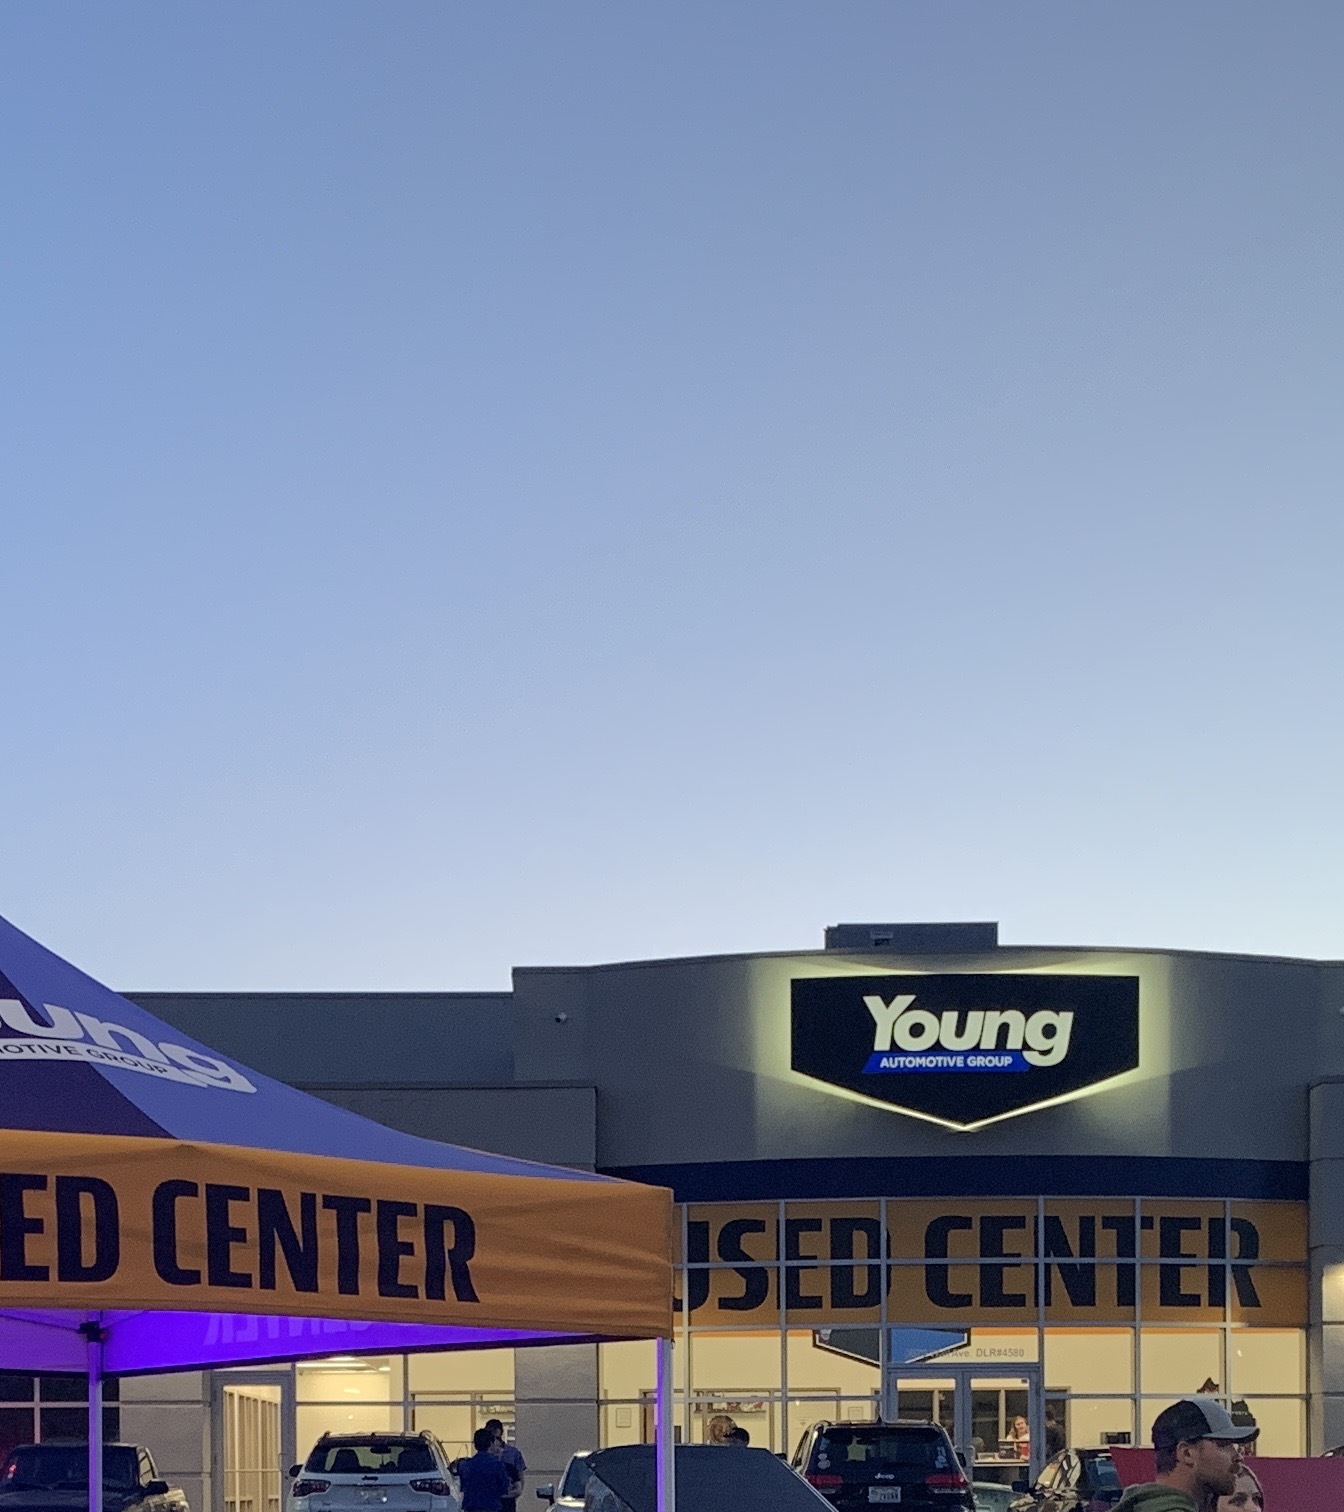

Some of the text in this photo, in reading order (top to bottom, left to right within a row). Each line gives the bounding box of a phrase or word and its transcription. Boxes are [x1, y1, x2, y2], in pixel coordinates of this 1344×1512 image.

[862, 994, 1074, 1067] Young
[86, 1048, 169, 1075] GROUP
[879, 1055, 1013, 1069] AUTOMOTIVE GROUP
[152, 1179, 481, 1304] CENTER
[924, 1215, 1262, 1308] CENTER
[976, 1348, 1025, 1358] DLR#4580
